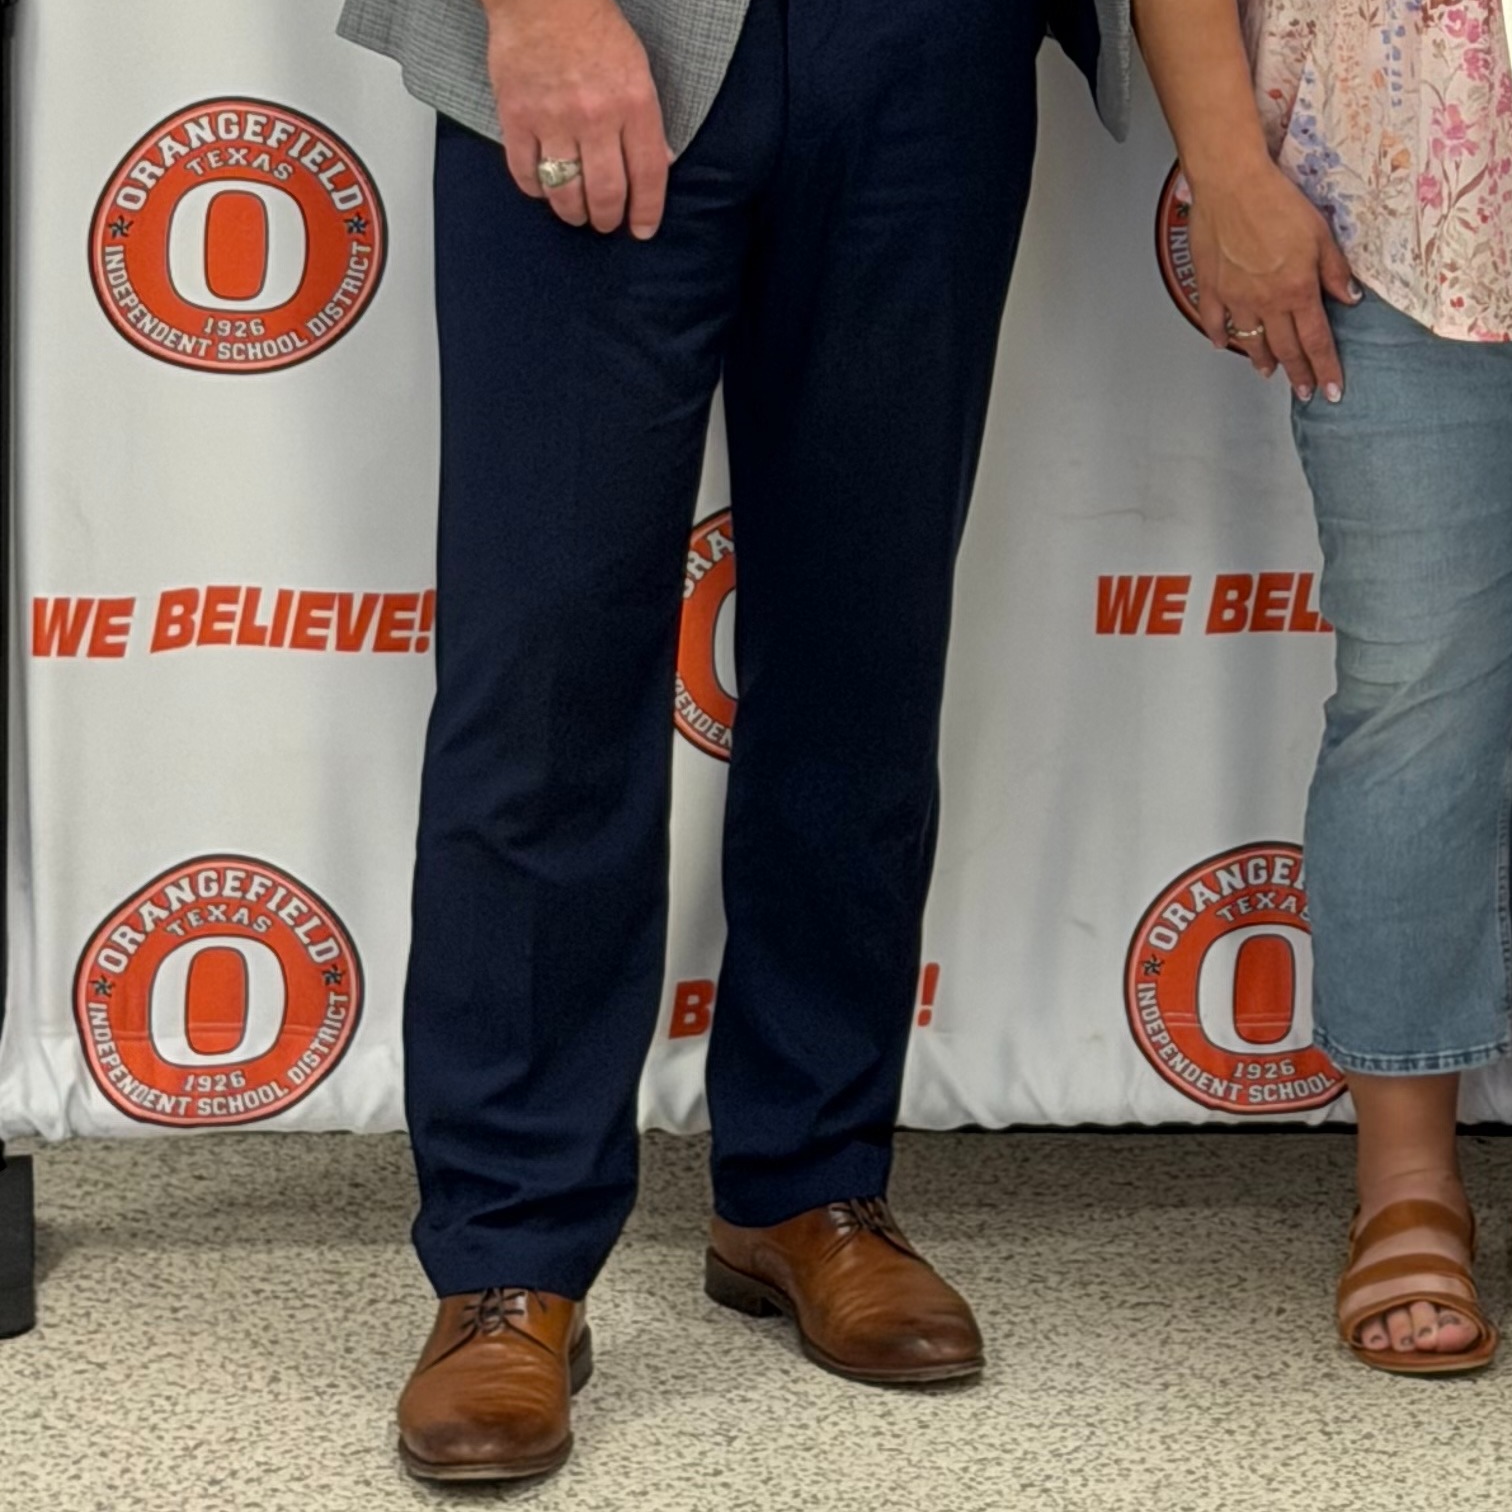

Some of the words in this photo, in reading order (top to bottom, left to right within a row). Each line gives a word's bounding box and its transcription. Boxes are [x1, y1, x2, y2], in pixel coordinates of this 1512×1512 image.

[116, 112, 363, 211] ORANGEFIELD
[186, 148, 293, 180] TEXAS
[169, 180, 307, 311] O
[105, 245, 212, 359] INDEPENDENT
[217, 330, 308, 360] SCHOOL
[305, 241, 372, 336] DISTRICT
[204, 317, 265, 336] 1926
[32, 598, 134, 658] WE
[151, 586, 436, 653] BELIEVE!
[1096, 576, 1189, 634] WE
[97, 870, 340, 974] ORANGEFIELD
[166, 904, 272, 937] TEXAS
[1149, 858, 1305, 951] ORANGE
[150, 936, 286, 1067] O
[1138, 983, 1243, 1101] INDEPENDENT
[1249, 1072, 1336, 1102] SCHOOL
[88, 1002, 192, 1116] INDEPENDENT
[197, 1081, 289, 1115] SCHOOL
[287, 992, 348, 1085] DISTRICT
[184, 1071, 246, 1092] 1926
[1233, 1059, 1296, 1079] 1926
